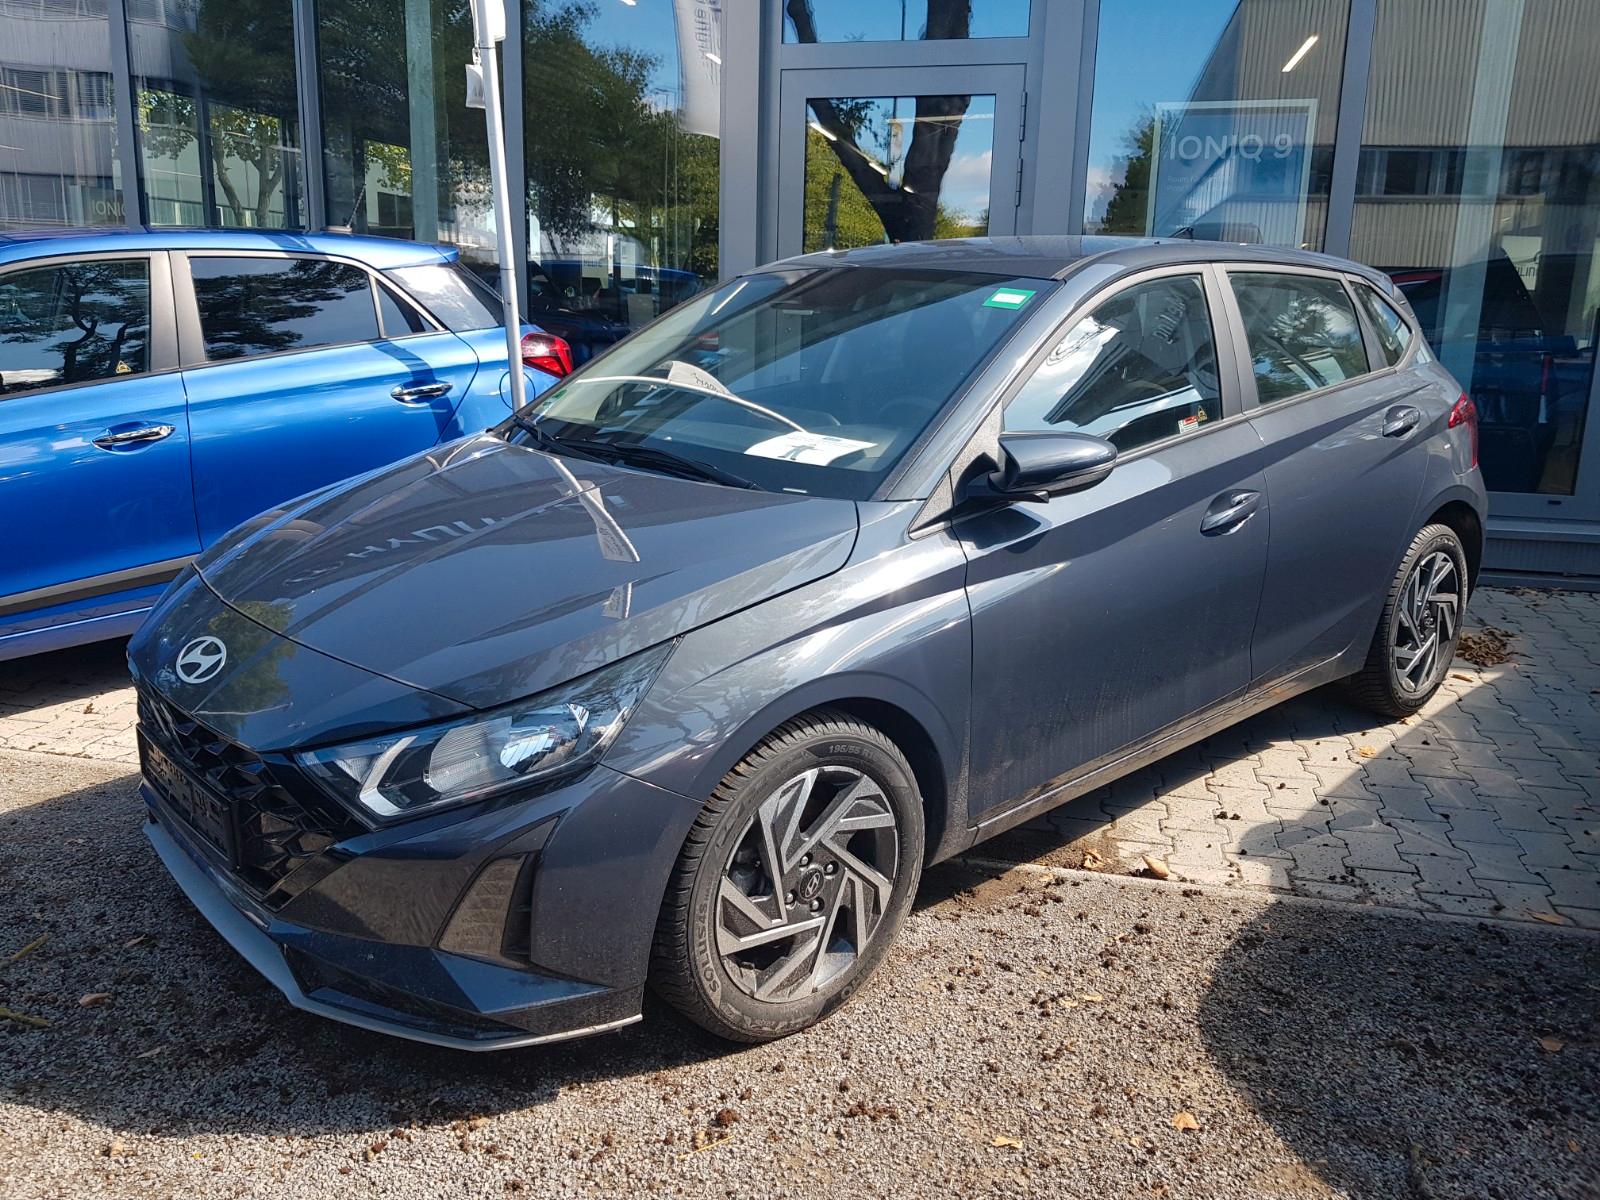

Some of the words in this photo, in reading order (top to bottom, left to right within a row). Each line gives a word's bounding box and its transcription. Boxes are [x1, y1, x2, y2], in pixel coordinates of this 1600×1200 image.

[1169, 134, 1264, 163] IONIQ
[1273, 133, 1293, 158] 9
[829, 744, 861, 754] 195/55
